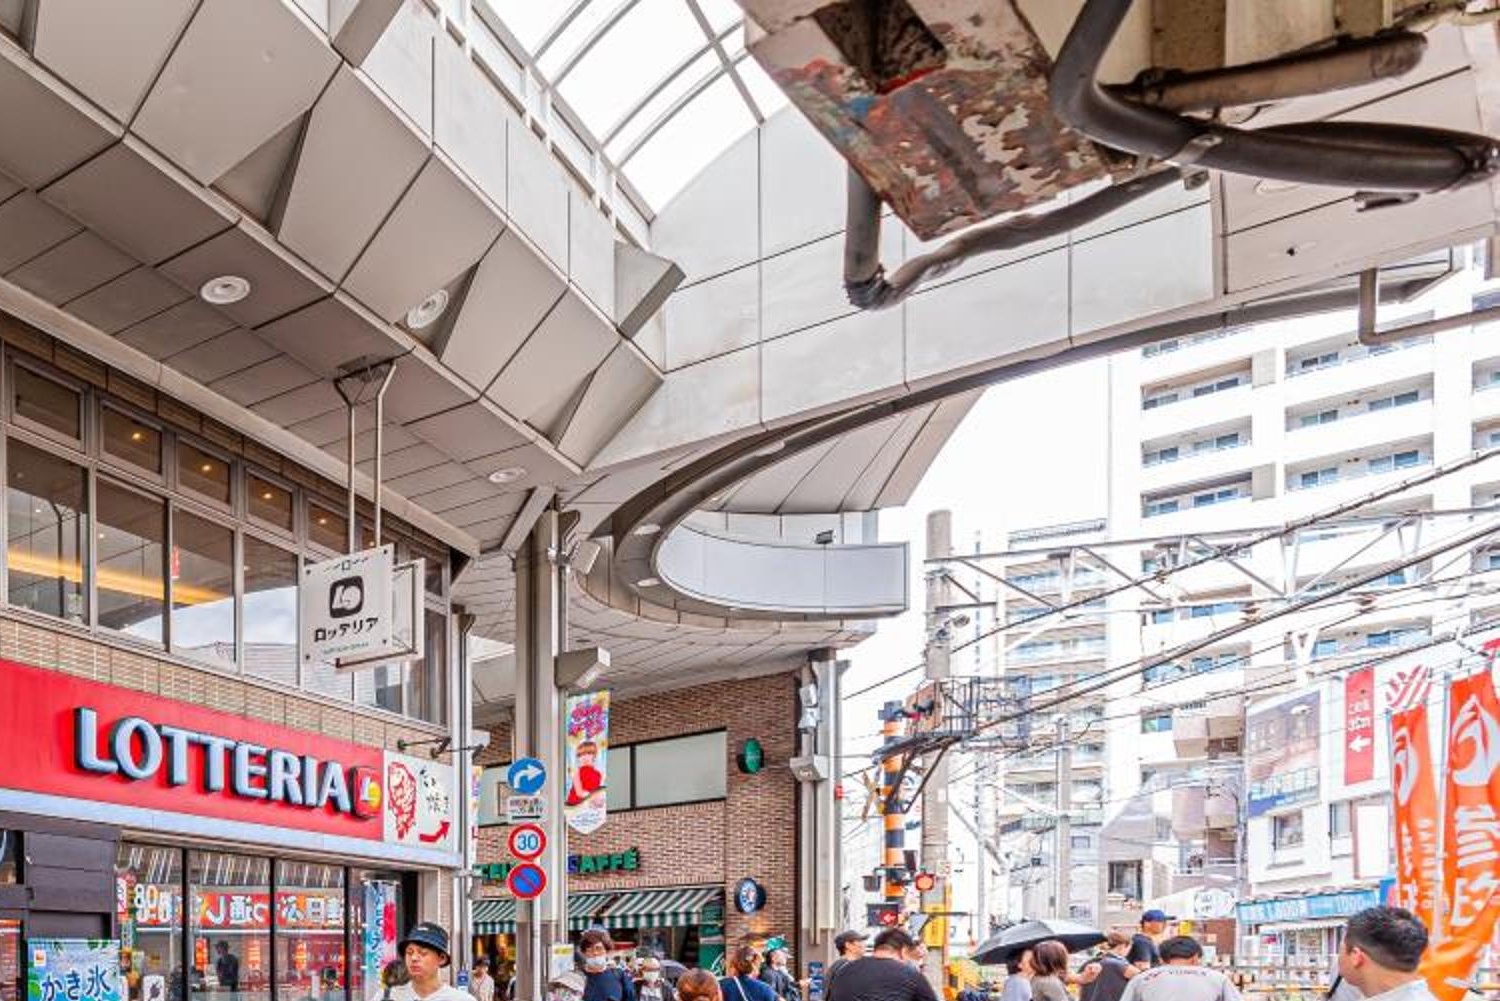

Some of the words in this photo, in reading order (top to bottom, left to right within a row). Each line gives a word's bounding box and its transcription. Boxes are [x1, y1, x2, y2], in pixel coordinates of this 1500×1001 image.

[314, 617, 378, 642] ロッテリア
[75, 706, 352, 813] LOTTERIA
[517, 833, 539, 850] 30
